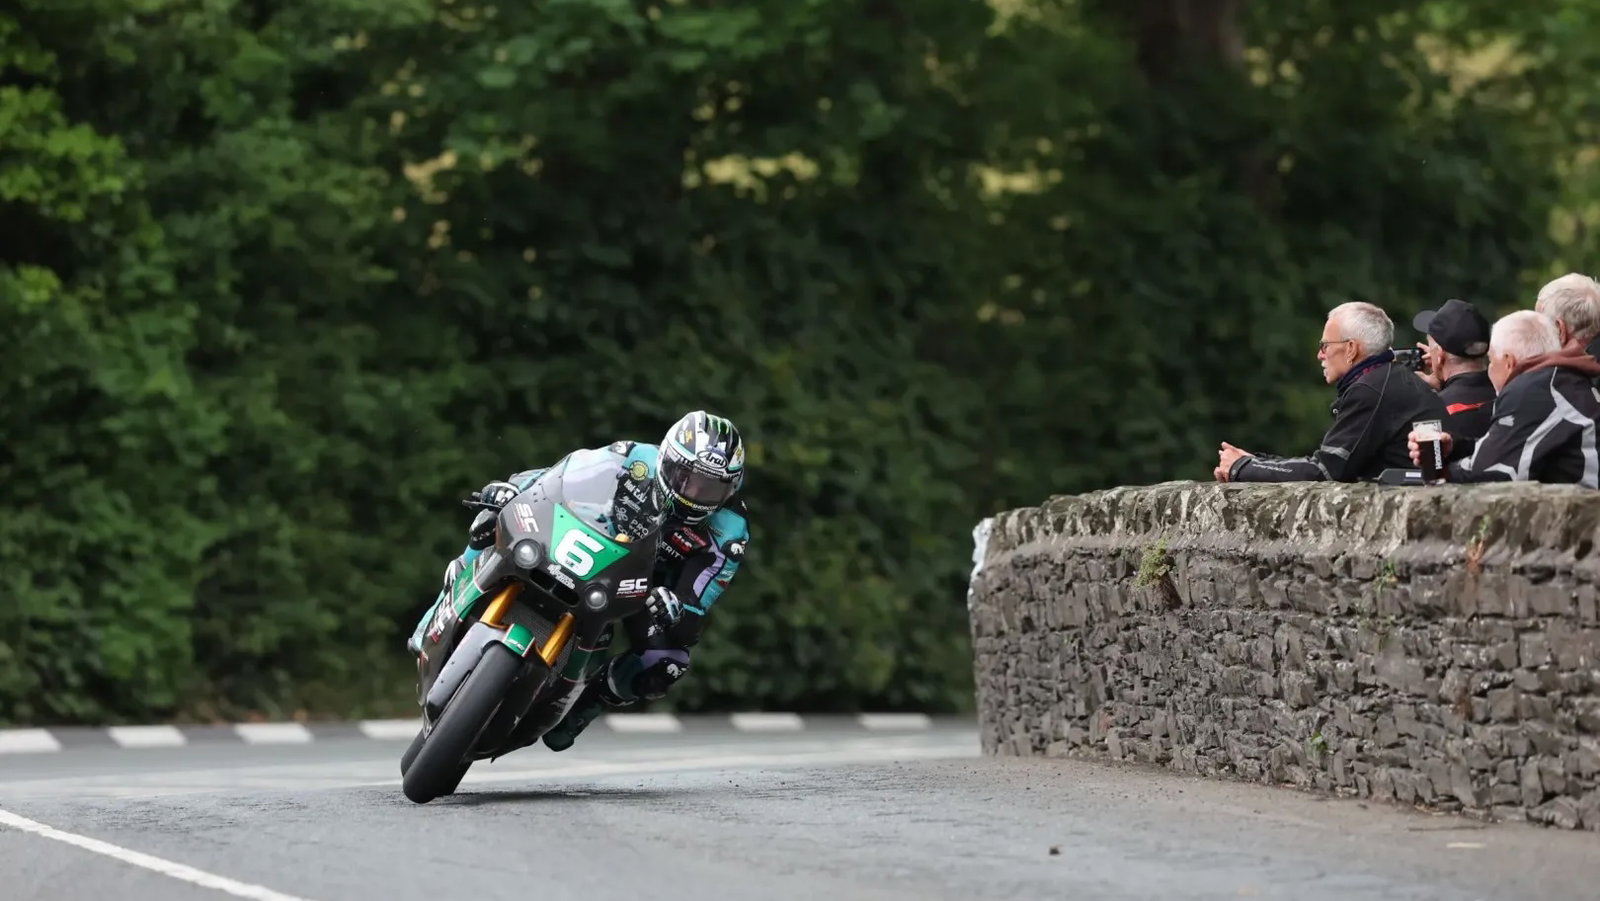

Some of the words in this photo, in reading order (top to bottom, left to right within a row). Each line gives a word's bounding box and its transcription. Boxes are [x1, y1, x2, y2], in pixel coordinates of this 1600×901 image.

[702, 452, 725, 466] Arai
[518, 503, 540, 533] SC
[631, 518, 649, 536] PRO
[555, 528, 604, 577] 6
[617, 577, 648, 592] SC
